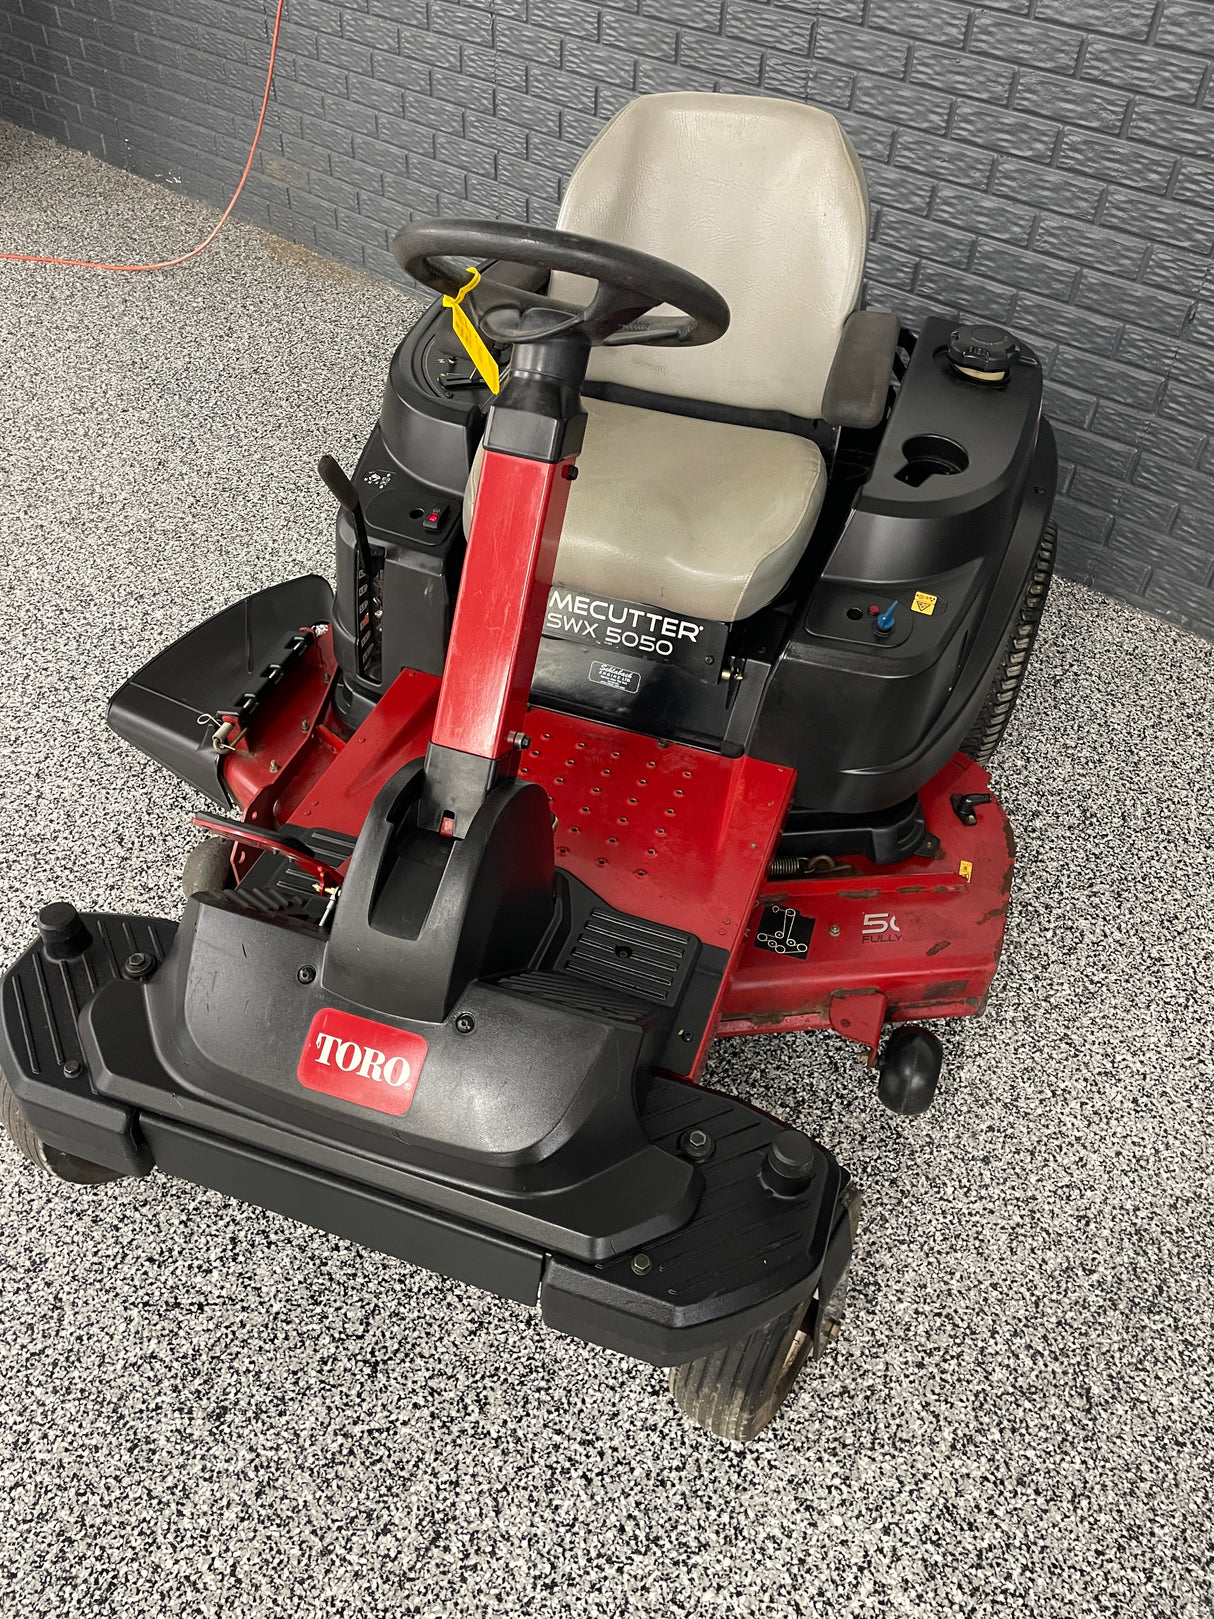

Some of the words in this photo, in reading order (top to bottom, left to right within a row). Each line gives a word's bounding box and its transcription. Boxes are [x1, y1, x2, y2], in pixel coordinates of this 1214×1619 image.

[546, 612, 599, 639] SWX
[605, 626, 674, 656] 5050
[861, 933, 902, 944] FULLY
[314, 1032, 411, 1088] TORO
